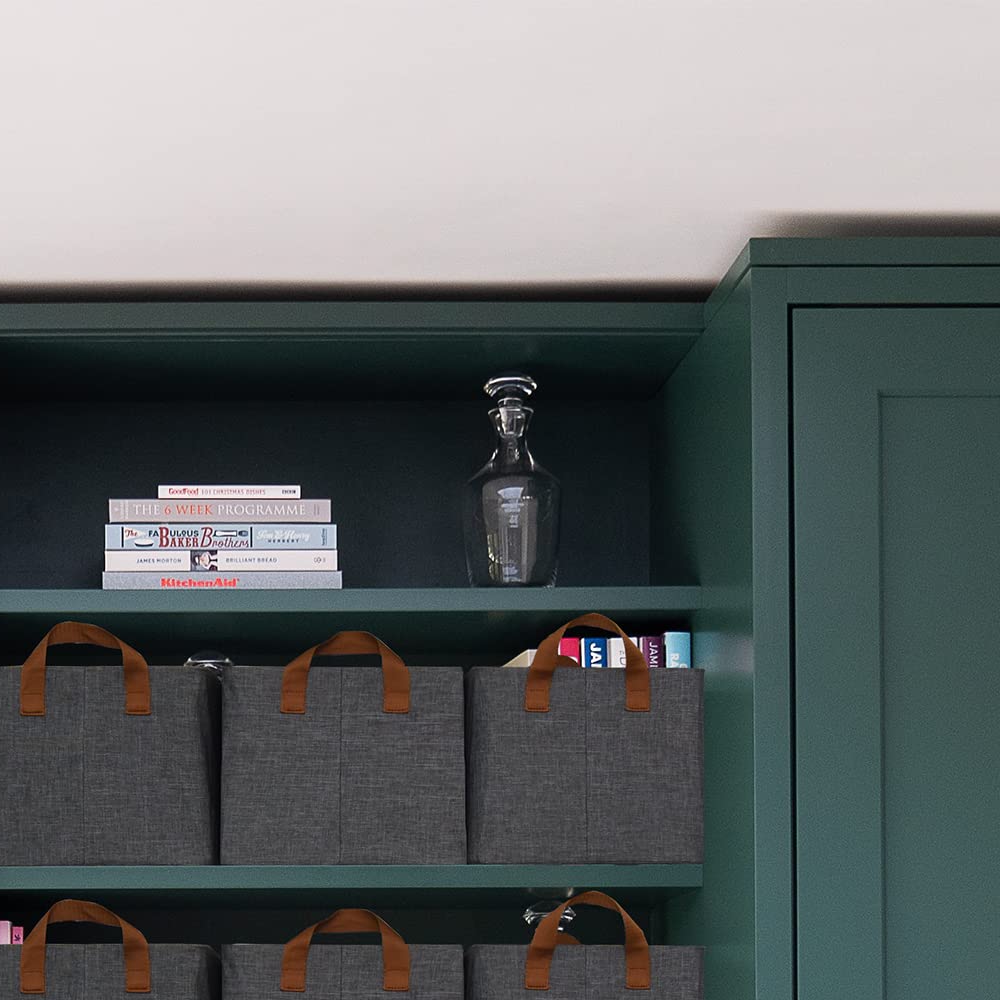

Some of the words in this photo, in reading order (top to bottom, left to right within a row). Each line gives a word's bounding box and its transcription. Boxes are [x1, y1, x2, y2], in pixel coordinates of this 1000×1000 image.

[133, 504, 160, 515] THE
[164, 504, 172, 515] 6
[176, 504, 213, 515] WEEK
[218, 504, 306, 515] PROGRAMME
[125, 529, 138, 537] The
[159, 530, 199, 548] BAKER
[161, 578, 238, 587] KitchenAid
